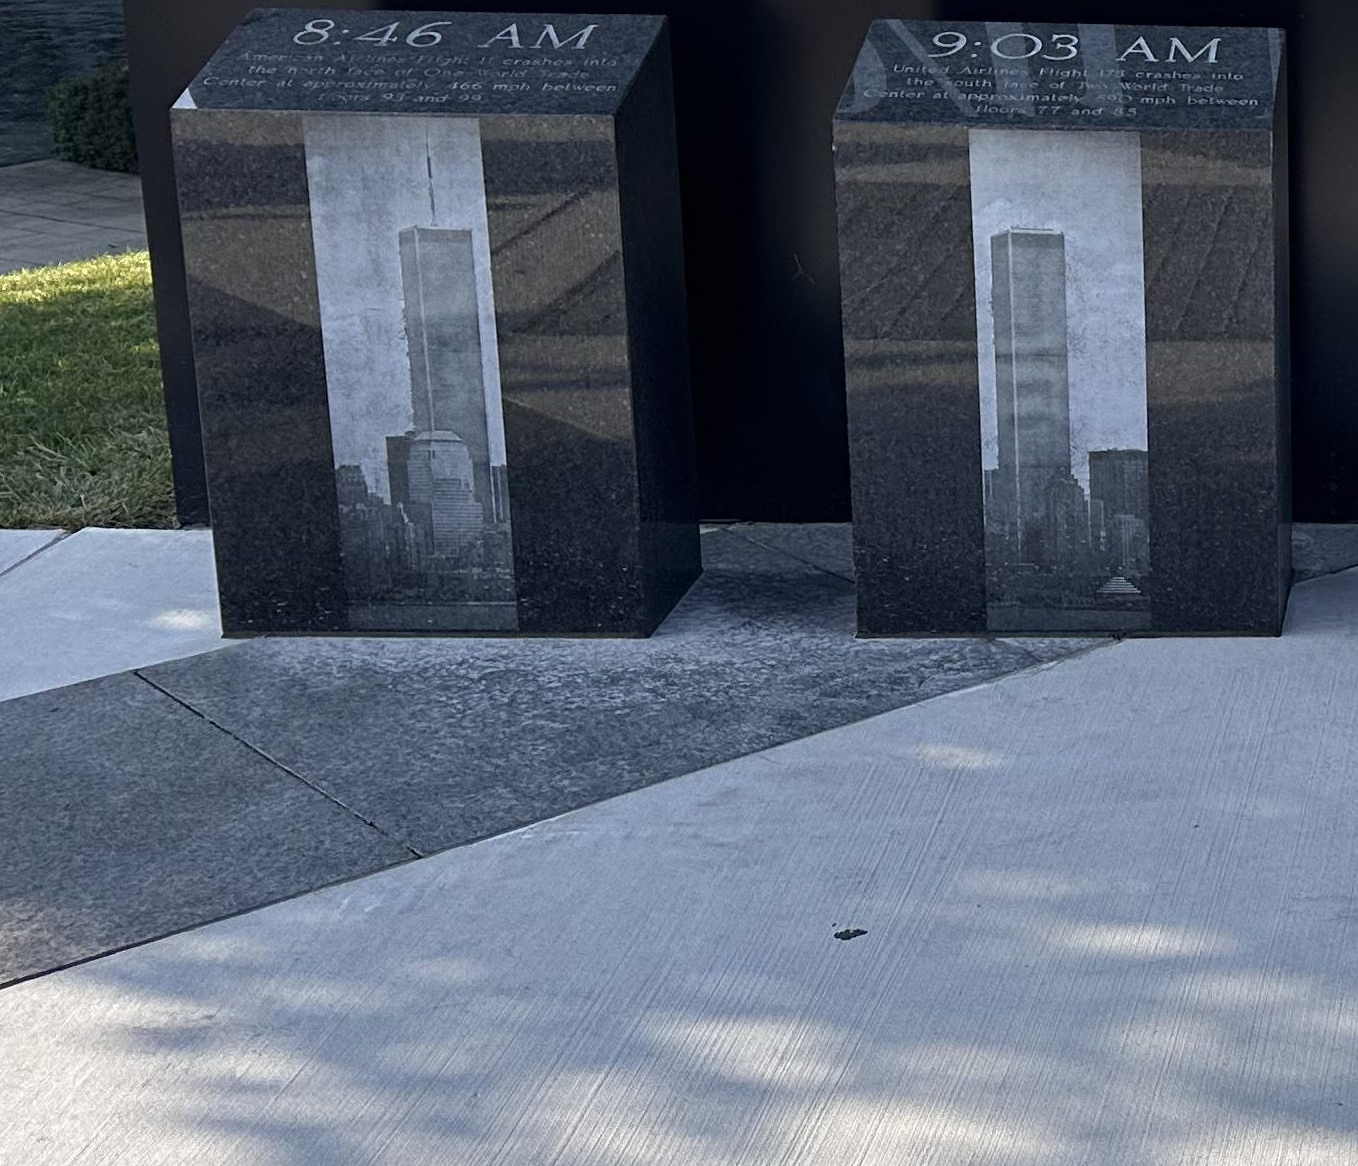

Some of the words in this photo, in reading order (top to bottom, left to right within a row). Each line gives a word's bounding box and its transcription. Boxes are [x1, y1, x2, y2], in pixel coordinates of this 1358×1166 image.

[292, 18, 452, 49] 8:46
[476, 22, 600, 51] AM
[927, 31, 1079, 61] 9:03
[1115, 35, 1222, 64] AM
[502, 56, 573, 67] crashes
[584, 57, 618, 67] into
[247, 64, 277, 75] the
[394, 66, 413, 77] of
[424, 66, 464, 77] One
[892, 63, 950, 75] United
[959, 64, 1029, 76] Airlines
[1038, 65, 1088, 78] Flight
[1134, 70, 1202, 80] crashes
[1211, 71, 1244, 81] into
[203, 75, 267, 87] Center
[276, 78, 294, 88] at
[302, 78, 433, 91] approximately
[492, 81, 531, 92] mph
[541, 81, 617, 92] between
[906, 76, 934, 87] the
[944, 77, 992, 88] outh
[1049, 80, 1065, 90] of
[1119, 82, 1168, 92] World
[1181, 82, 1225, 93] Trade
[413, 92, 449, 103] and
[863, 88, 926, 99] Center
[932, 90, 949, 100] at
[957, 92, 1083, 104] approximately
[1140, 95, 1177, 106] mph
[1187, 95, 1259, 106] between
[1038, 105, 1062, 115] 77
[1071, 106, 1104, 116] and
